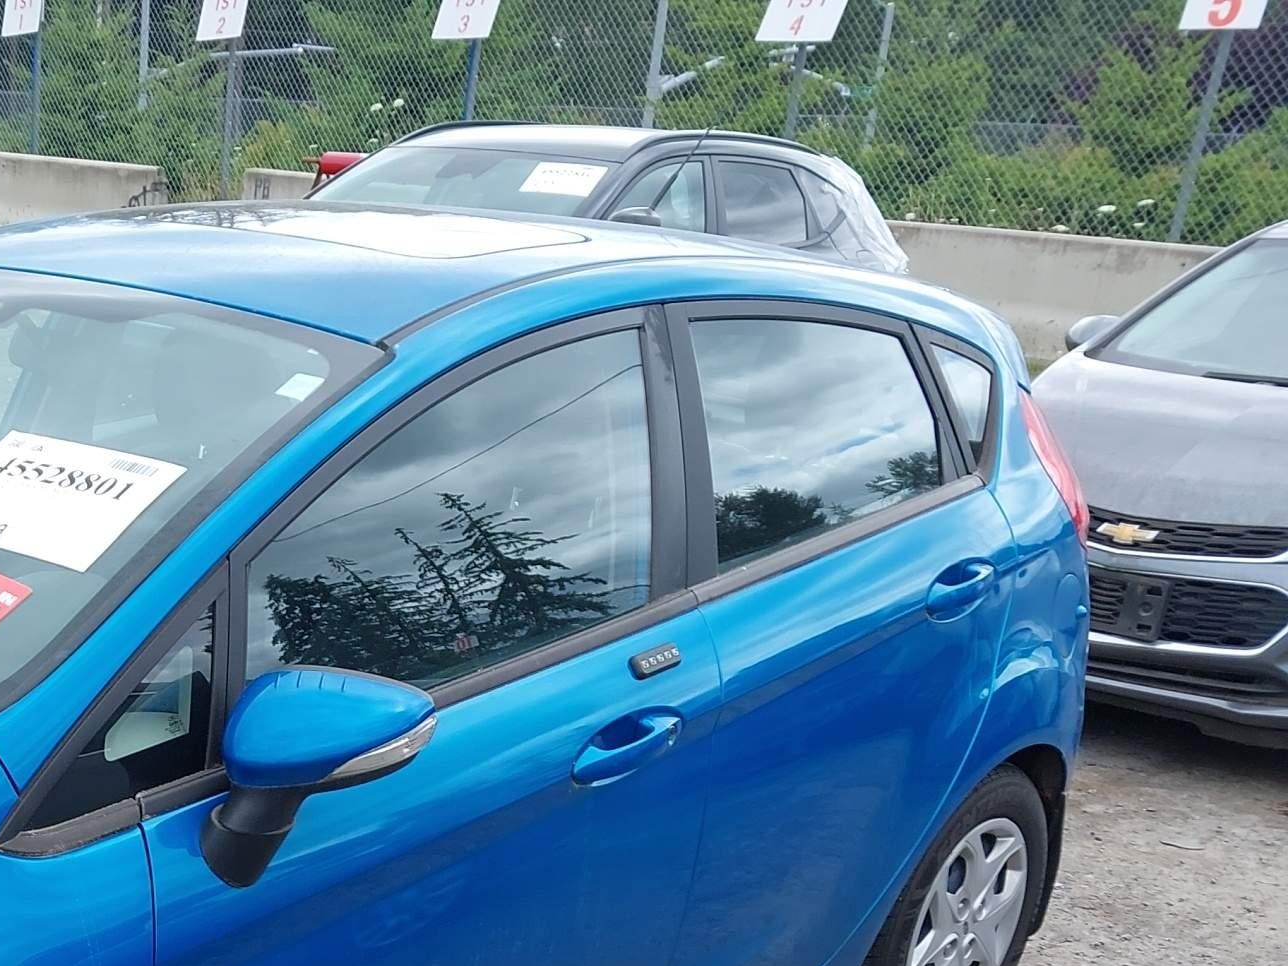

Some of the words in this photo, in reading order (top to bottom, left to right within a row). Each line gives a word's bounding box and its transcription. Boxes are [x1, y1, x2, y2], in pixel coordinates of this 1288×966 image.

[216, 17, 226, 34] 2
[458, 15, 470, 33] 3
[790, 15, 804, 36] 4
